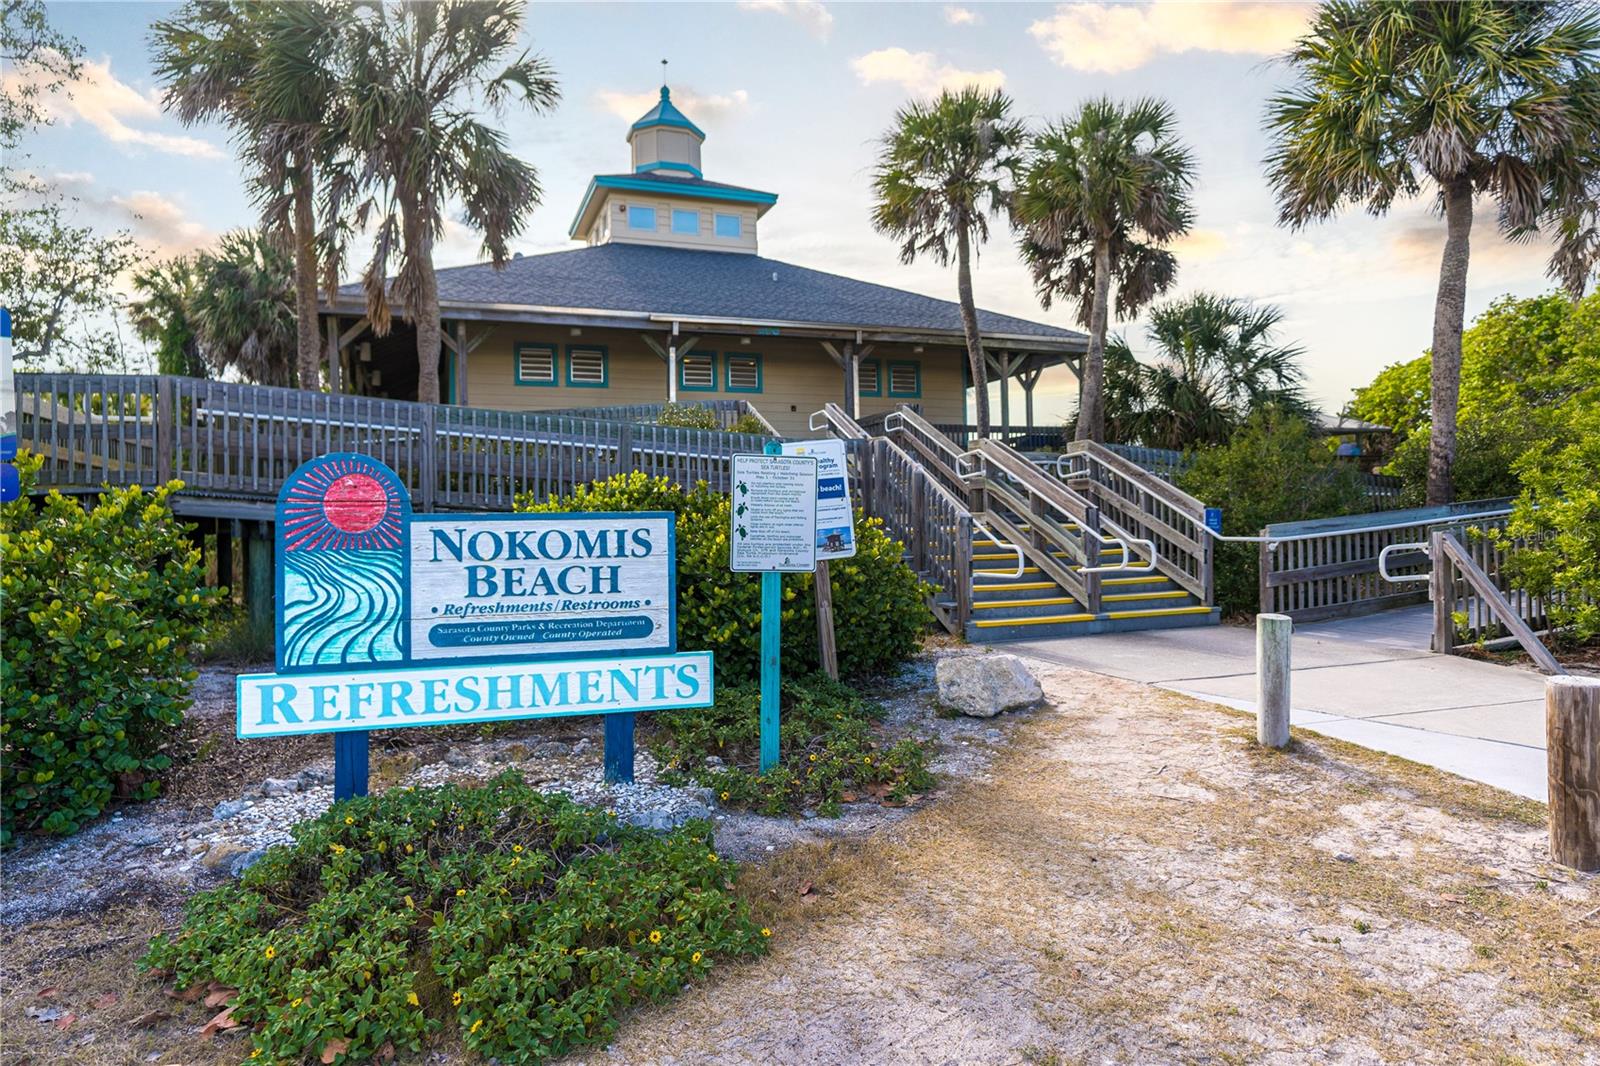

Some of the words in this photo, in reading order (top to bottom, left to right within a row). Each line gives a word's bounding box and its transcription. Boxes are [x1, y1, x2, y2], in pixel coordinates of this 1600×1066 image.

[820, 484, 842, 492] beach!
[429, 528, 653, 562] NOKOMIS
[464, 565, 622, 598] BEACH
[443, 599, 641, 619] Refreshments/Restrooms
[437, 624, 476, 633] Sarasota
[477, 623, 510, 633] County
[511, 622, 537, 631] Parks
[538, 622, 545, 630] &
[548, 620, 595, 629] Recreation
[596, 619, 646, 628] Department
[463, 634, 499, 643] County
[501, 633, 535, 641] Owned
[542, 631, 577, 640] County
[578, 629, 623, 639] Operated
[255, 664, 699, 725] REFRESHMENTS
